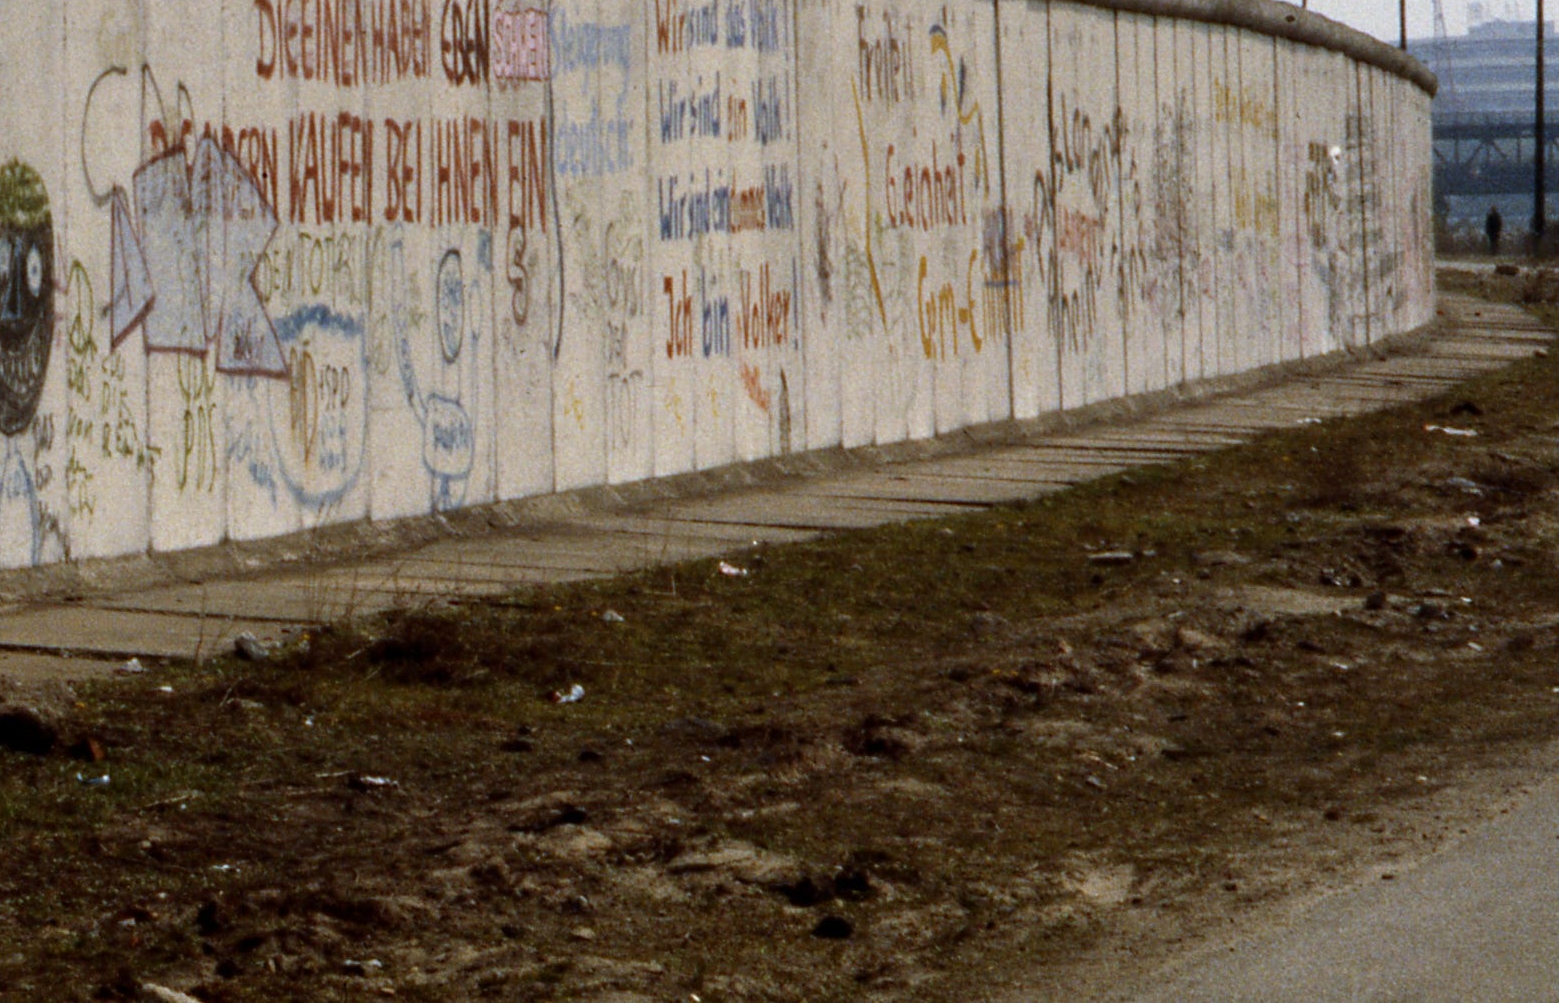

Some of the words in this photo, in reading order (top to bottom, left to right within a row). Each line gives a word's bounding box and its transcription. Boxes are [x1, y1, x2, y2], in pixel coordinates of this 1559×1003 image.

[659, 76, 687, 144] Wir
[288, 111, 374, 226] KAUFEN
[384, 117, 423, 224] BEI
[507, 114, 548, 234] EIN
[658, 175, 687, 241] Wir
[701, 265, 731, 357] bin
